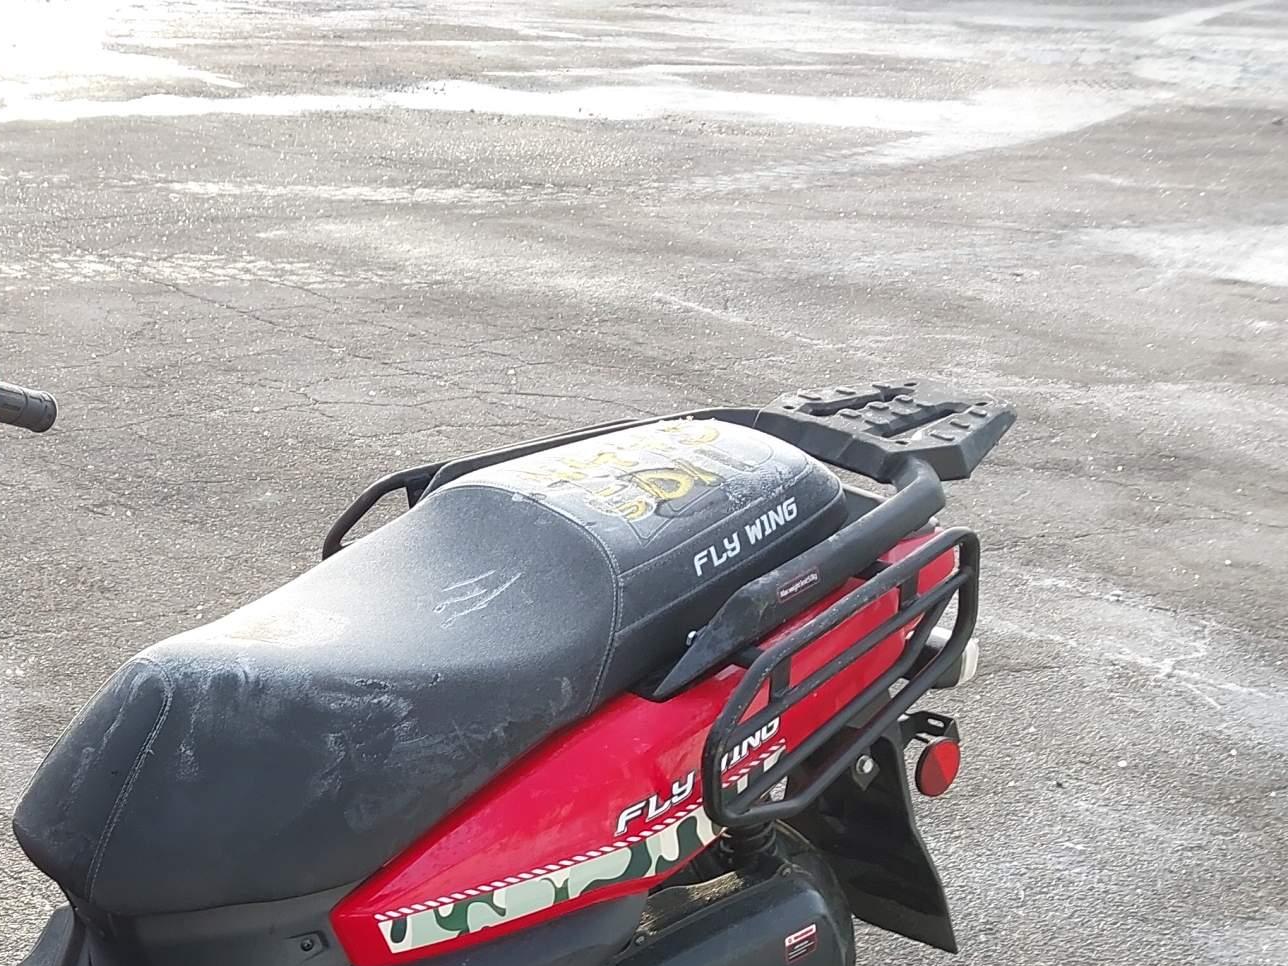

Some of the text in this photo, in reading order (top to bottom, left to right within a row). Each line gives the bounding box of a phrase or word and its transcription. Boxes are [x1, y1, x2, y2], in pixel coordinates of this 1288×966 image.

[693, 496, 799, 577] FLY WING
[614, 770, 696, 837] FLY
